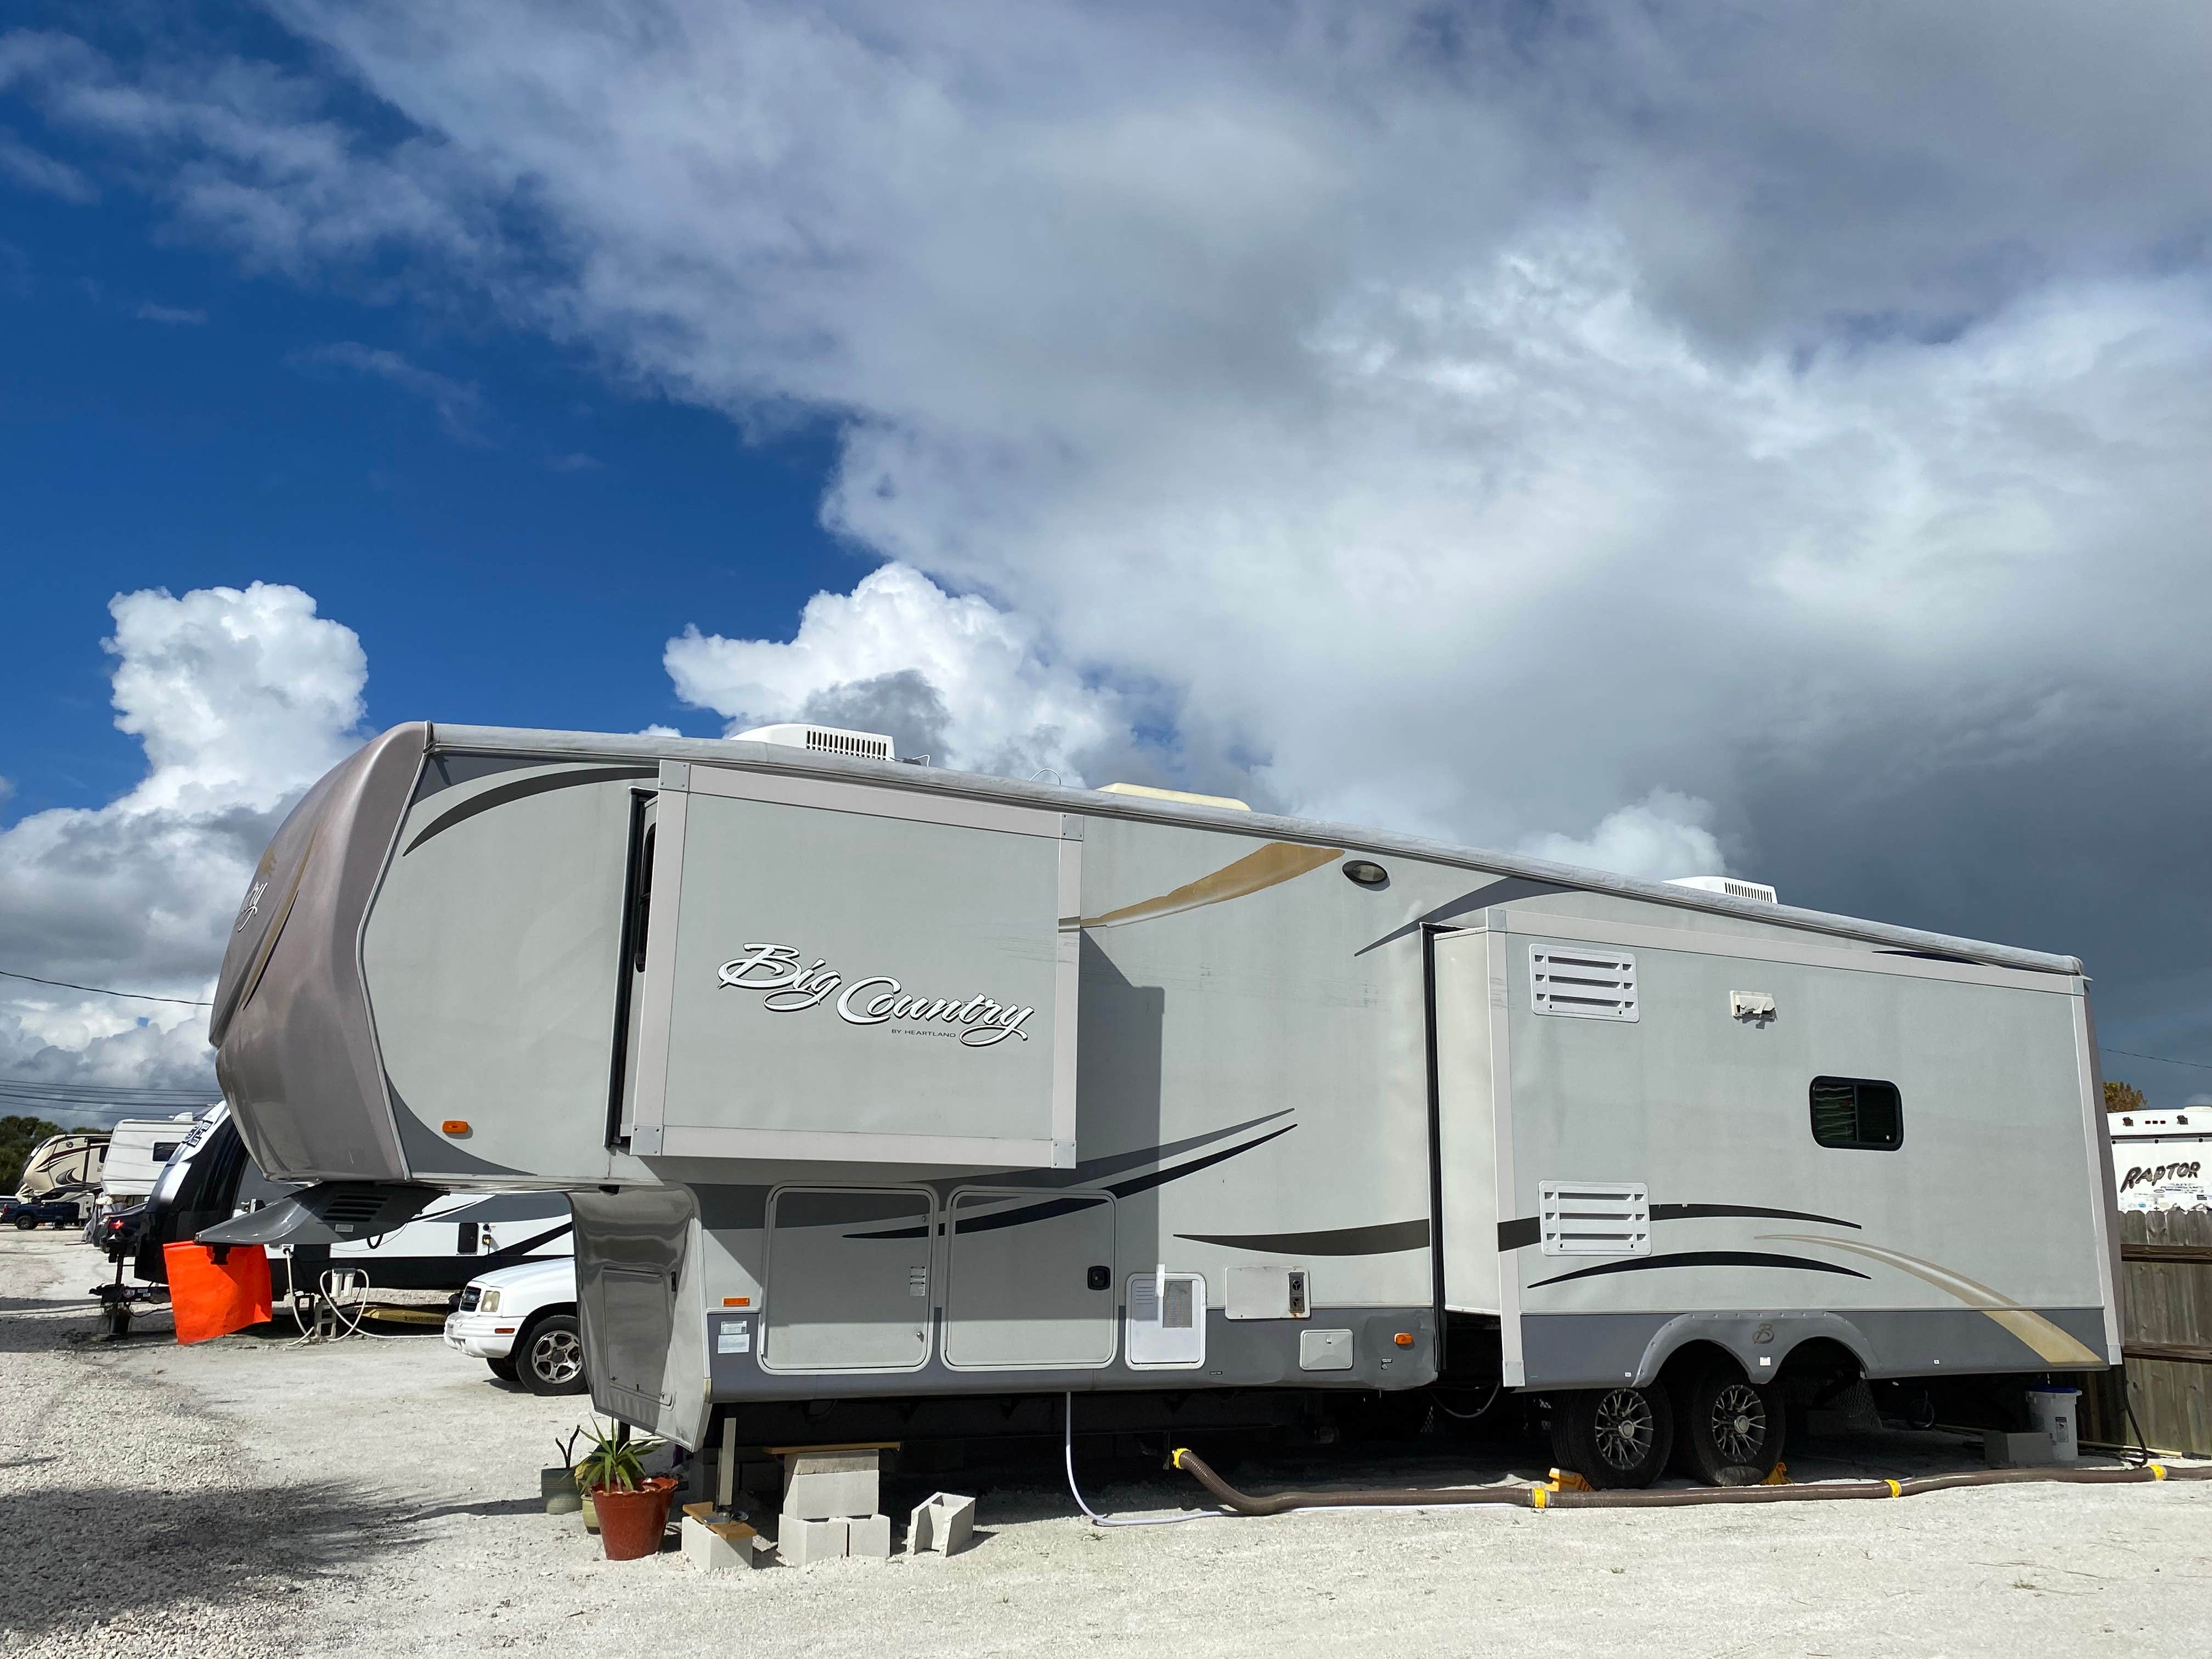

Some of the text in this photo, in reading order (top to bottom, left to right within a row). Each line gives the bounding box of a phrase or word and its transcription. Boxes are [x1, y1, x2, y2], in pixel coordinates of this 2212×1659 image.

[717, 943, 1035, 1047] Big Country
[904, 1030, 957, 1038] HEARTLAND
[2119, 1161, 2201, 1193] RAPTOR
